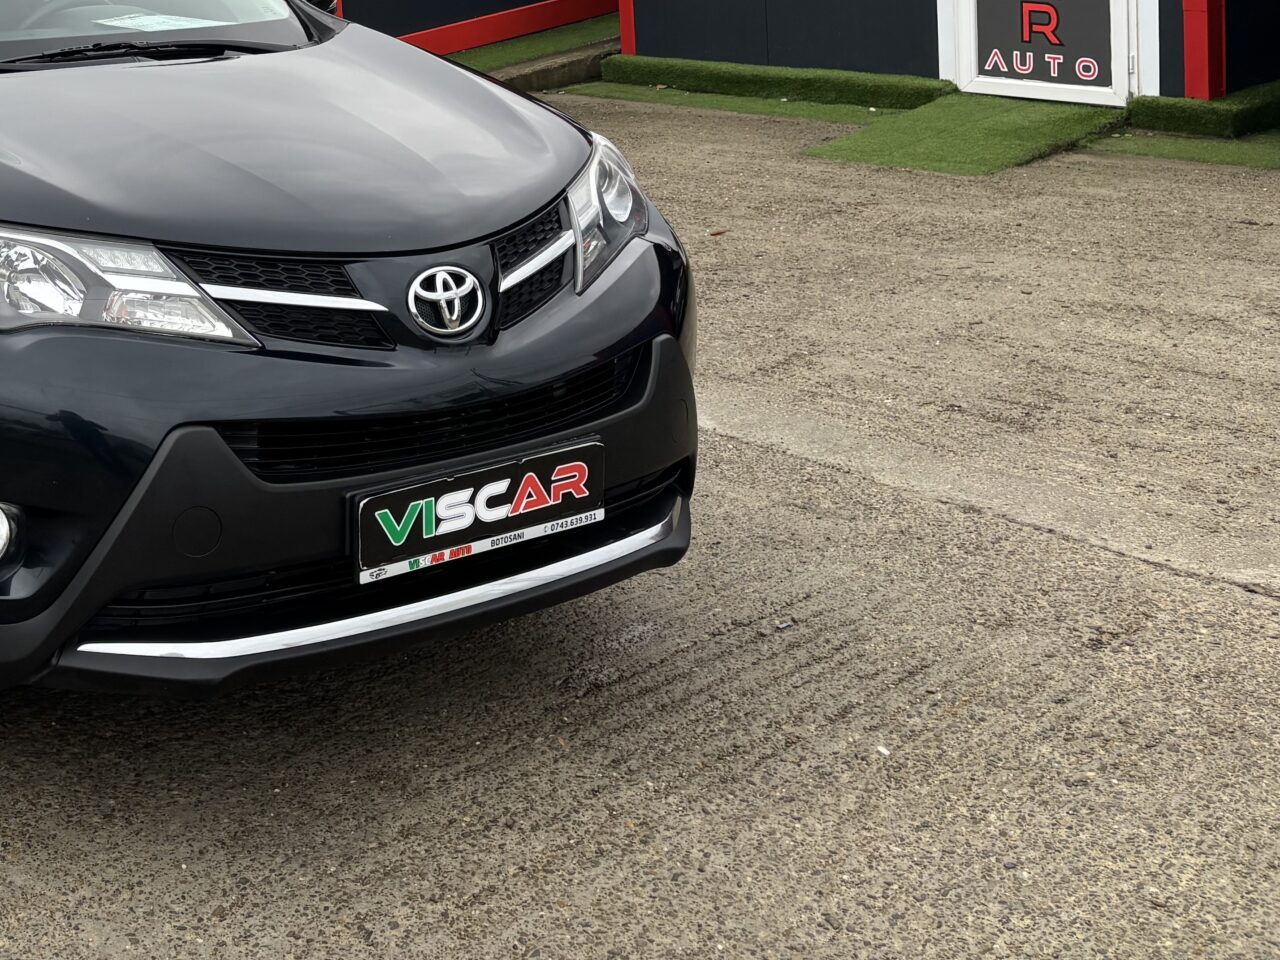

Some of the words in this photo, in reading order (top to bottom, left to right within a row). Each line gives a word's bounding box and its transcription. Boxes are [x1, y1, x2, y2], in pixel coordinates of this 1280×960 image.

[984, 48, 1099, 80] AUTO
[375, 462, 589, 546] VISCAR
[490, 532, 525, 548] BOTOSANI
[550, 513, 597, 532] 0743.639.931
